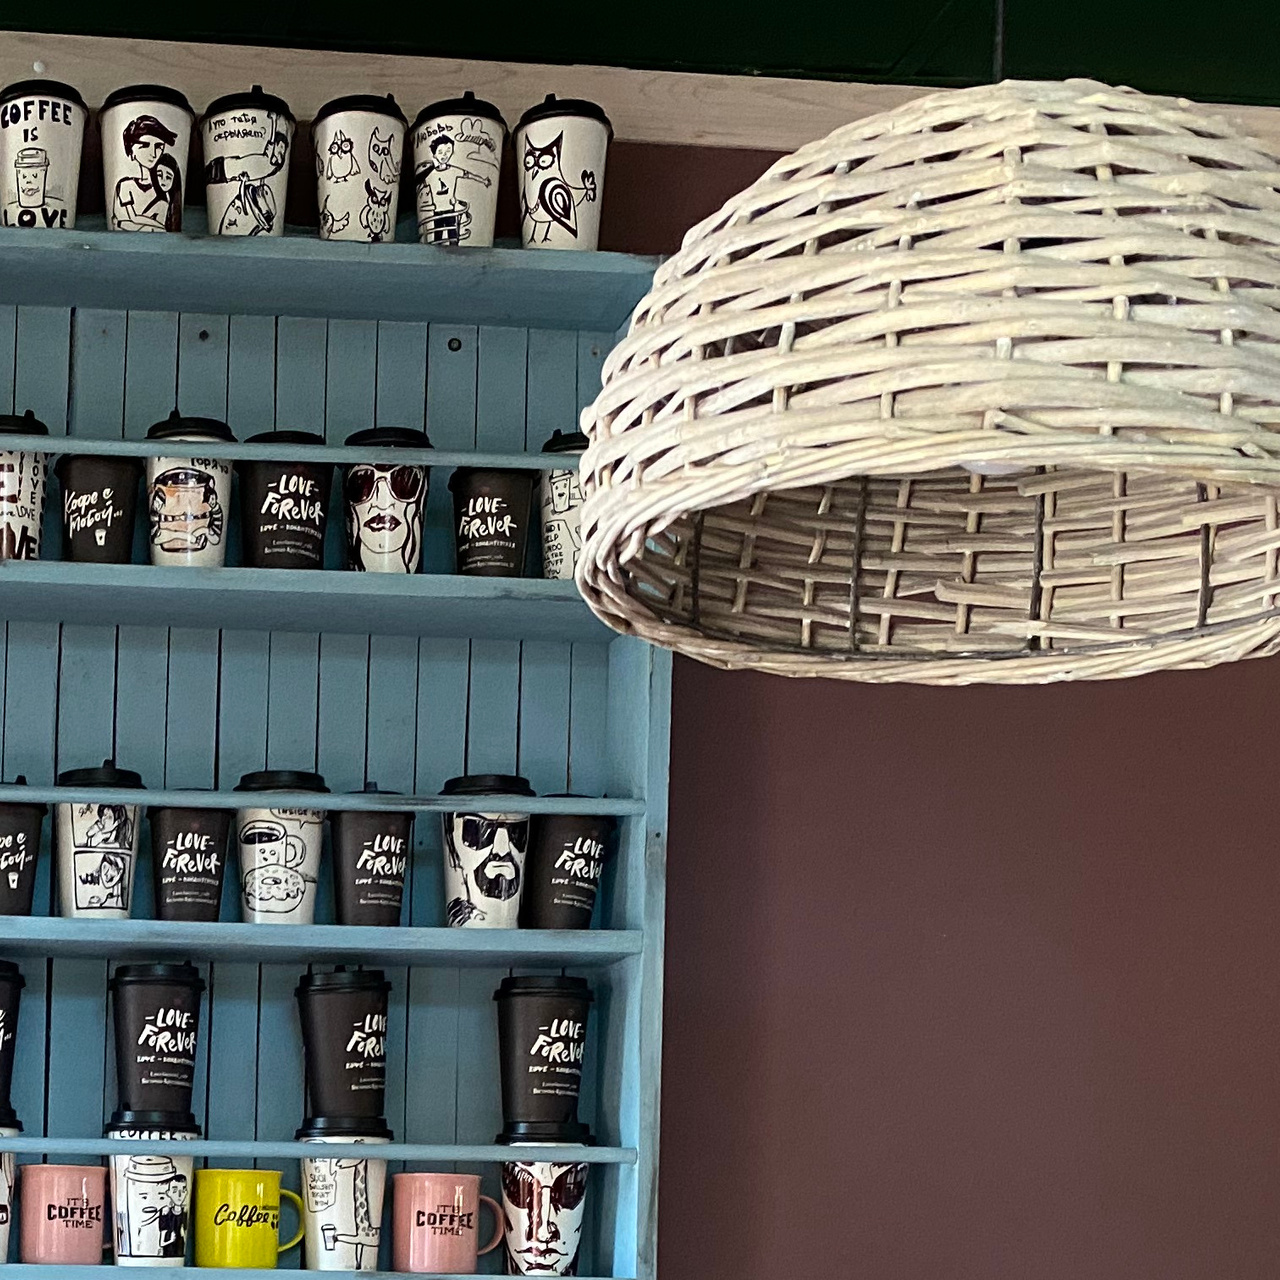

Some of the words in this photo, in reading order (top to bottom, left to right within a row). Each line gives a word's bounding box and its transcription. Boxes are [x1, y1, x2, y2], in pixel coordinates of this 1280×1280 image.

[1, 100, 72, 128] COFFEE
[23, 127, 38, 142] IS
[3, 208, 67, 229] LOVE
[279, 474, 315, 497] LOVE
[64, 489, 98, 525] Кофе
[468, 497, 502, 517] LOVE
[16, 832, 27, 844] с
[176, 832, 210, 851] LOVE
[373, 833, 404, 854] LOVE
[574, 836, 604, 858] LOVE
[156, 1007, 191, 1028] LOVE
[550, 1018, 582, 1039] LOVE
[47, 1204, 101, 1222] COFFEE
[214, 1203, 269, 1227] Coffee
[416, 1210, 473, 1229] COFFEE
[62, 1219, 93, 1229] TIME
[431, 1226, 463, 1236] TIME
